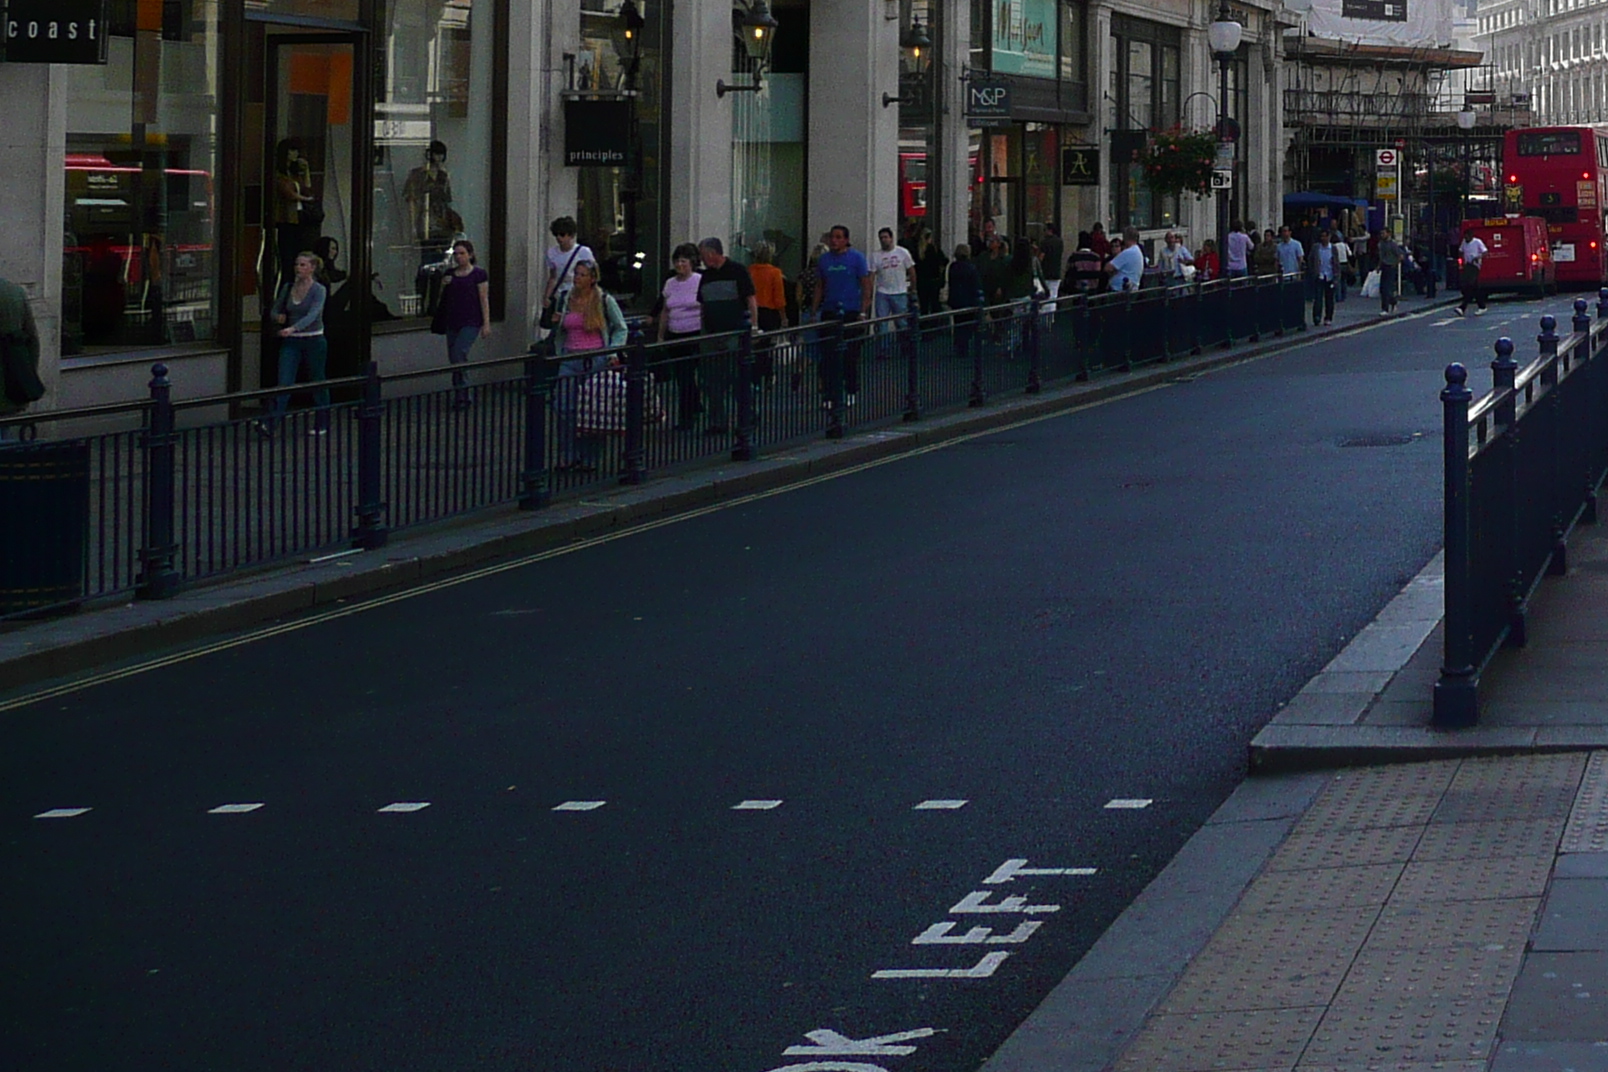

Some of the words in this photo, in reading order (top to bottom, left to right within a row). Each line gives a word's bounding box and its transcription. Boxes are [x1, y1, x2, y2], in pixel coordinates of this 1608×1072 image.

[8, 18, 97, 40] coast
[971, 87, 1006, 106] M&P
[570, 149, 624, 163] principles
[871, 858, 1098, 978] LEFT
